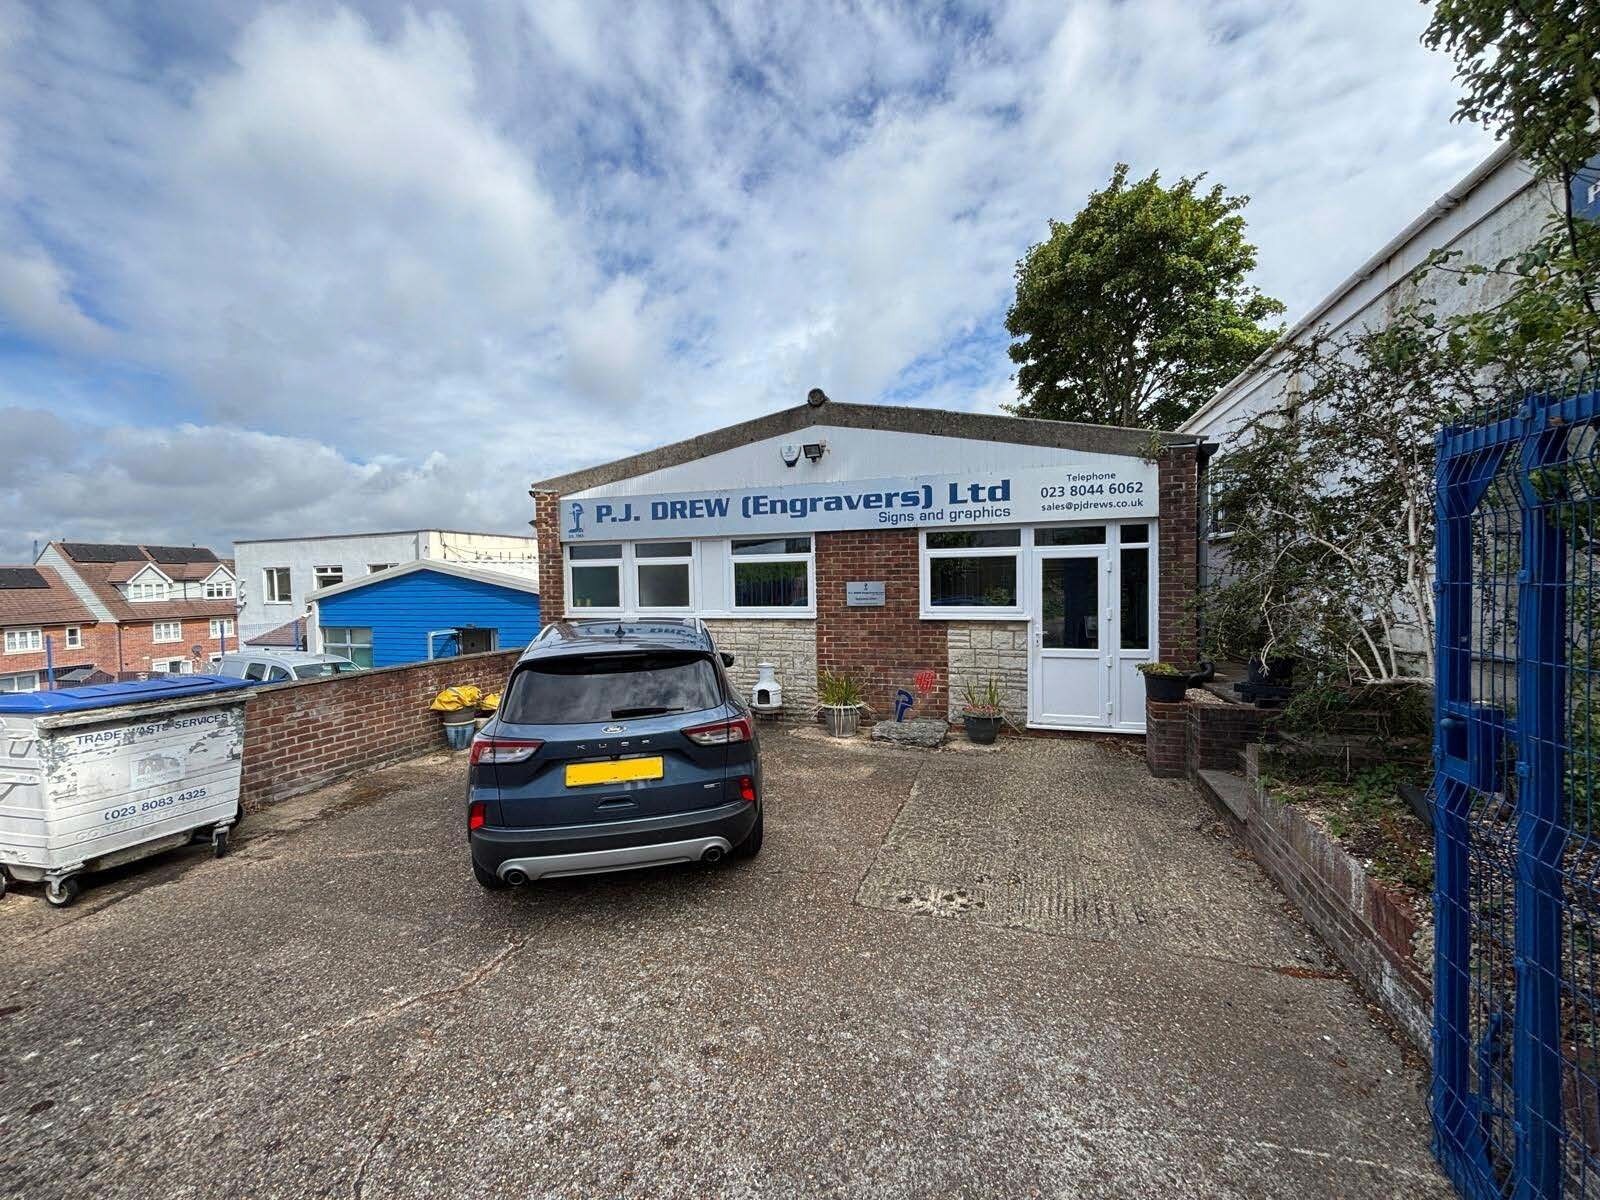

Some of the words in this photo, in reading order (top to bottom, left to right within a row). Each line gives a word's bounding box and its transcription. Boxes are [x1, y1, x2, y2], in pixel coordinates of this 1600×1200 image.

[1066, 471, 1117, 483] Telephone
[1040, 486, 1065, 498] 023
[1070, 484, 1104, 496] 8044
[1108, 481, 1144, 494] 6062
[595, 503, 641, 524] P.J.
[651, 497, 730, 521] DREW
[741, 484, 933, 519] (Engravers)
[948, 479, 1011, 505] Ltd
[1041, 498, 1144, 512] sales@pjdrews.co.uk
[878, 511, 915, 526] Signs
[919, 508, 944, 521] and
[949, 505, 1011, 522] graphics
[76, 730, 122, 745] TRADE
[174, 713, 228, 729] SERVICES
[141, 796, 174, 812] 8083
[177, 788, 207, 802] 4325
